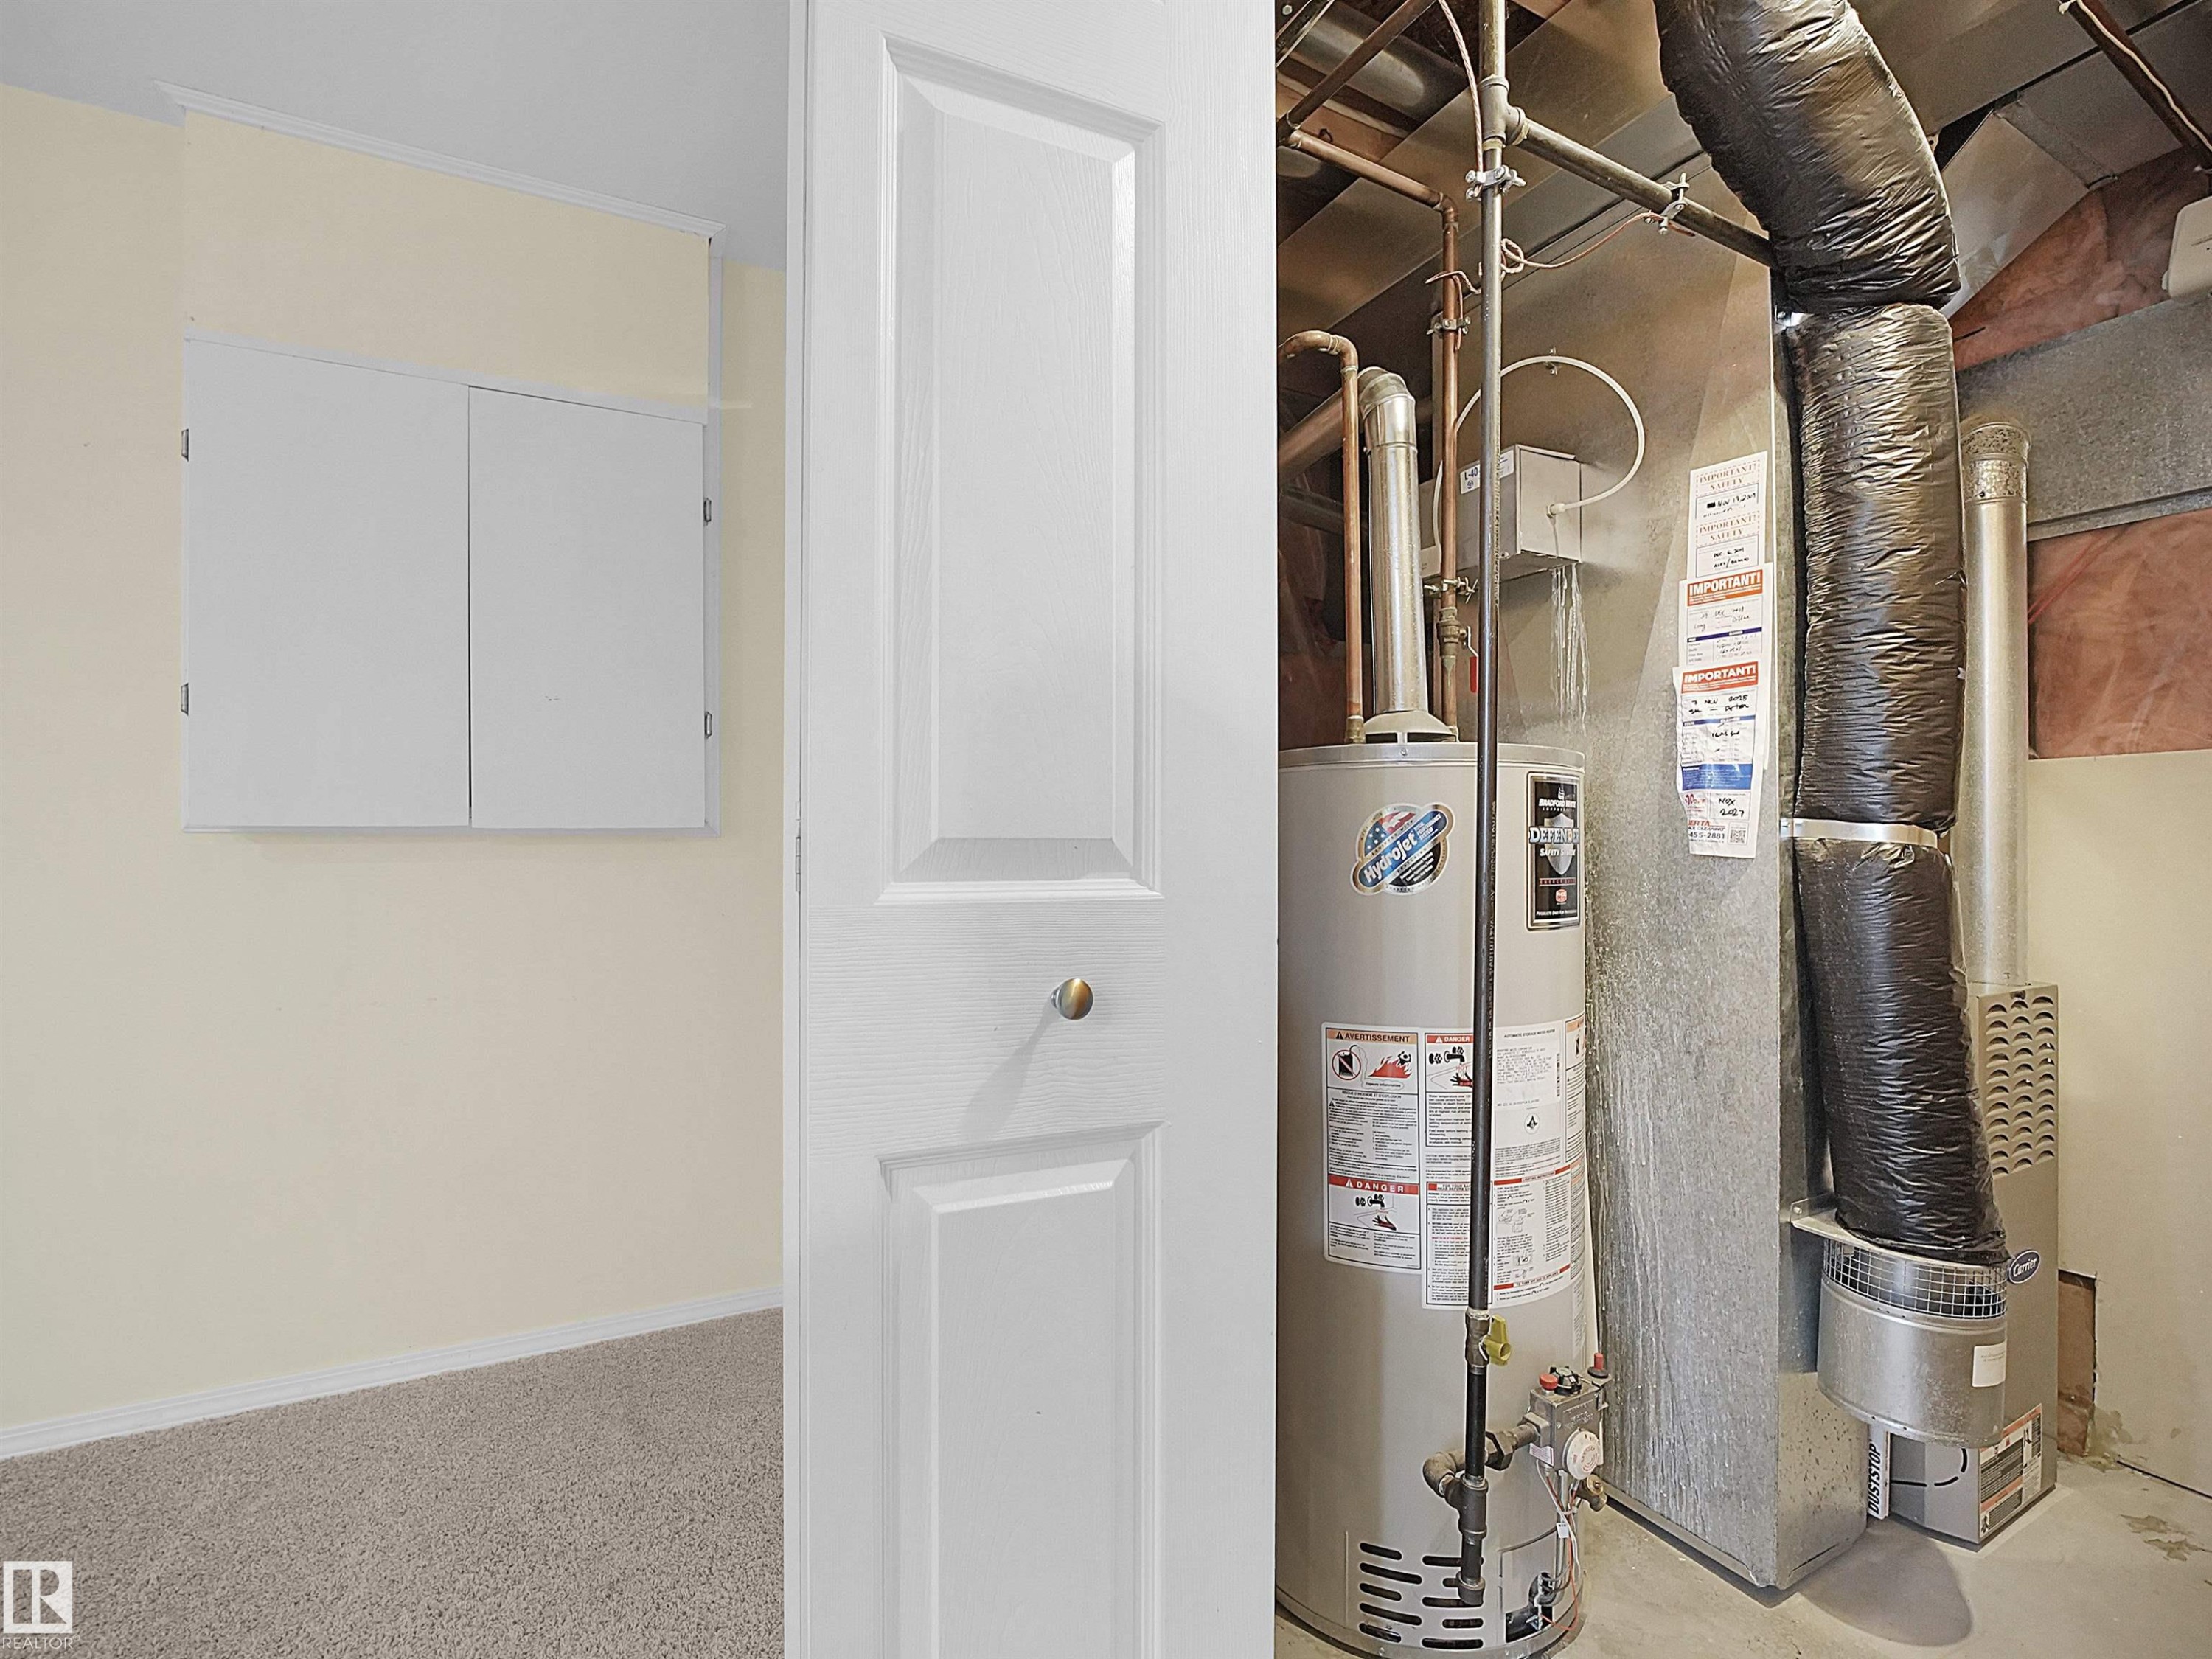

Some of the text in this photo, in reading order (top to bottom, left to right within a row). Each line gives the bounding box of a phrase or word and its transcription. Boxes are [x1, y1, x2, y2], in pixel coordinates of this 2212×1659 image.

[1700, 463, 1756, 483] IMPORTANT!
[1711, 478, 1742, 490] SAFETY
[1700, 514, 1756, 533] IMPORTANT!
[1711, 529, 1742, 540] SAFETY
[1689, 571, 1761, 596] IMPORTANT!
[1684, 664, 1756, 683] IMPORTANT!
[1364, 832, 1417, 883] Hydrojet
[1345, 1033, 1410, 1043] AVERTISSEMENT
[1357, 1181, 1404, 1193] DANGER
[2013, 1257, 2037, 1276] Carrier
[1868, 1443, 1881, 1514] DUSTSTOP
